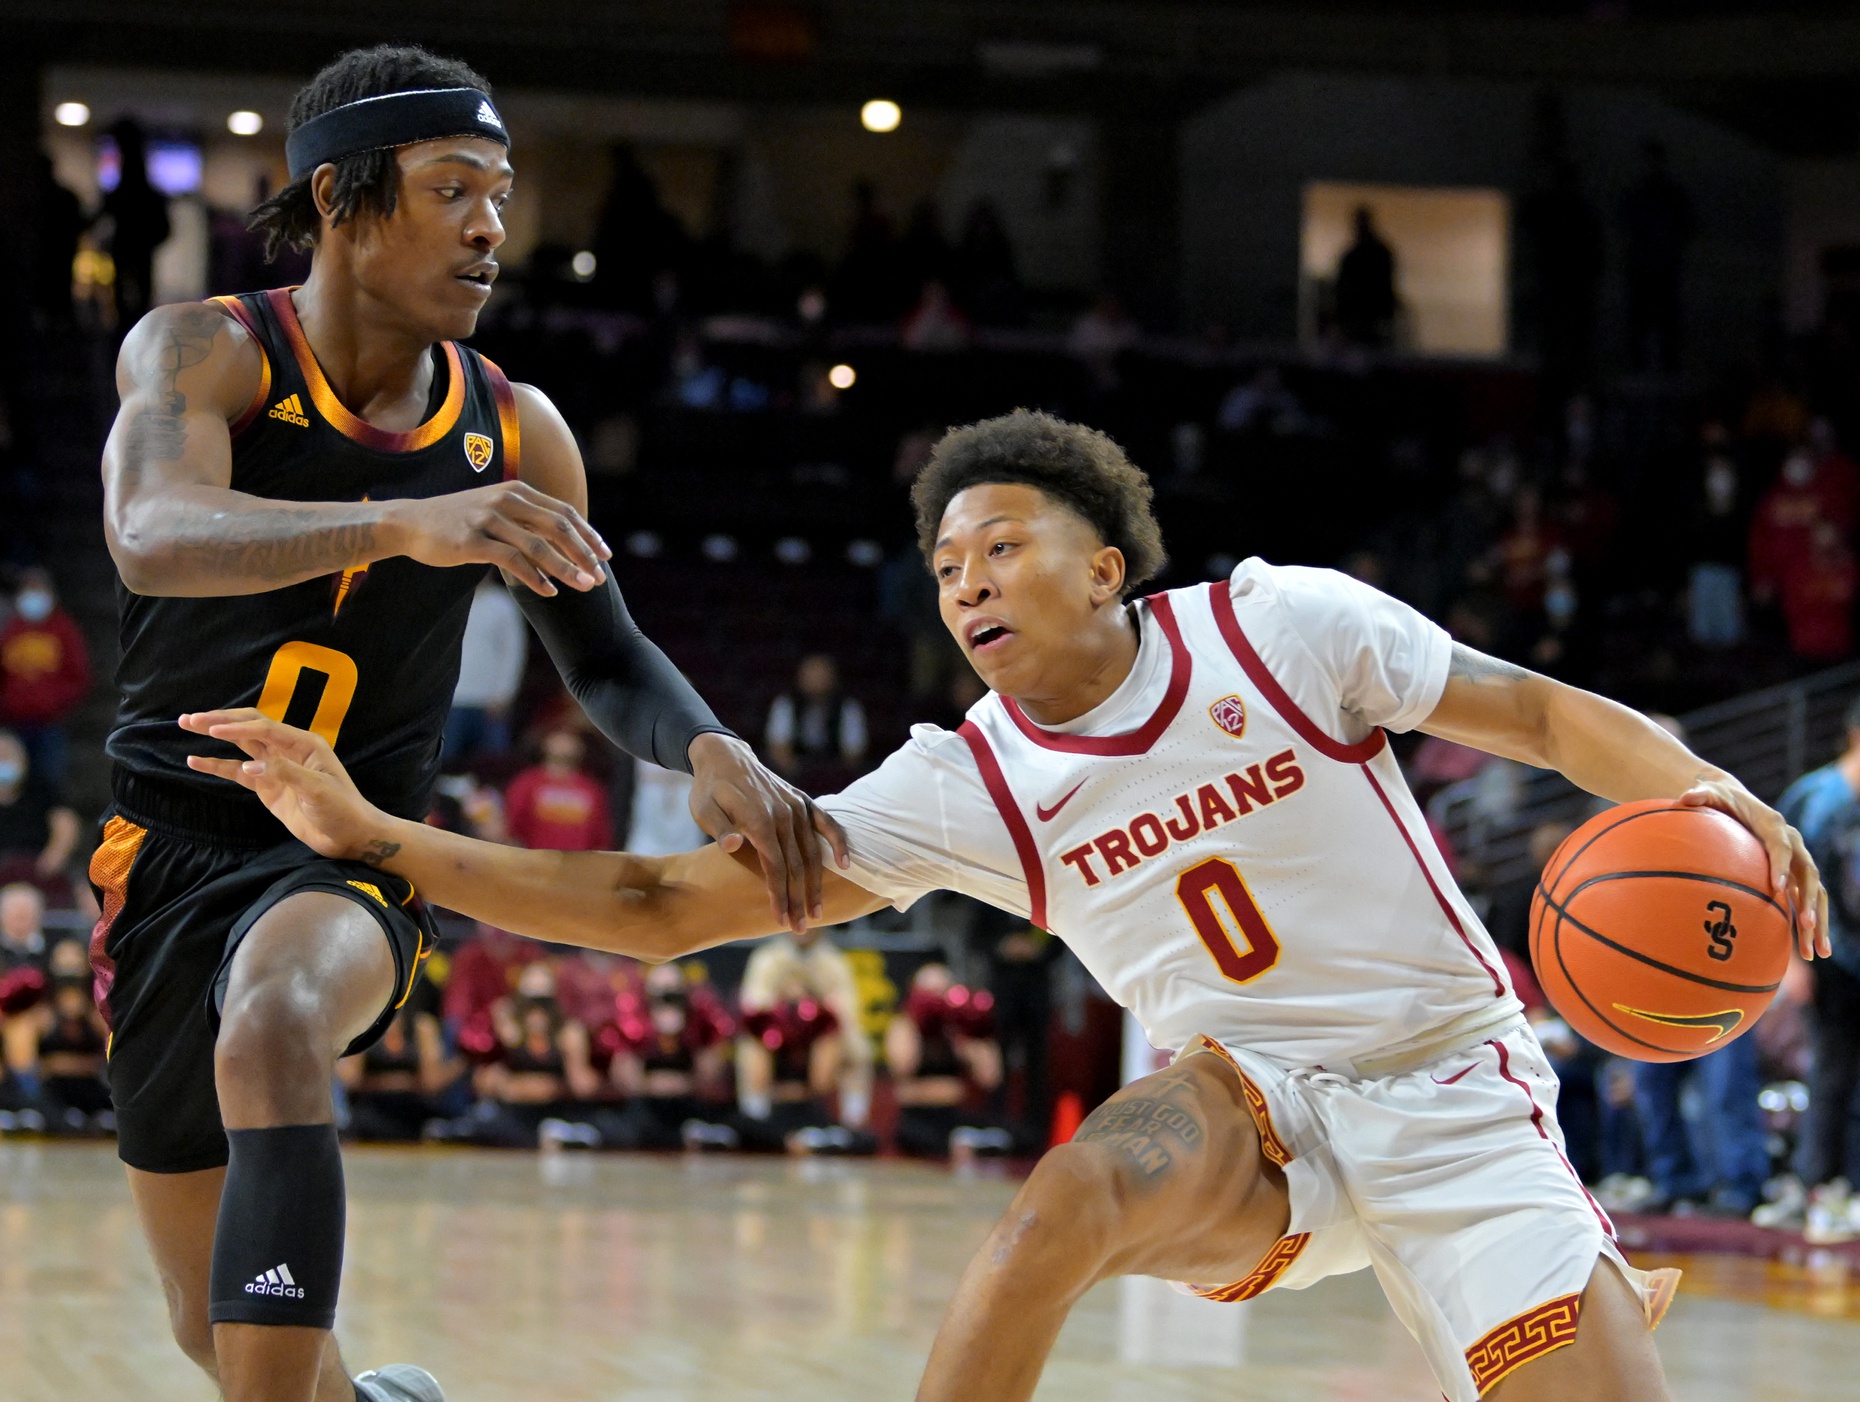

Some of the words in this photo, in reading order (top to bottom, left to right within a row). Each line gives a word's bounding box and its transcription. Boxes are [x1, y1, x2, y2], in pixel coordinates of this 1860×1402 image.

[268, 409, 310, 428] adidas
[1059, 748, 1305, 888] TROJANS
[1174, 855, 1282, 985] 0
[244, 1281, 305, 1299] adidas
